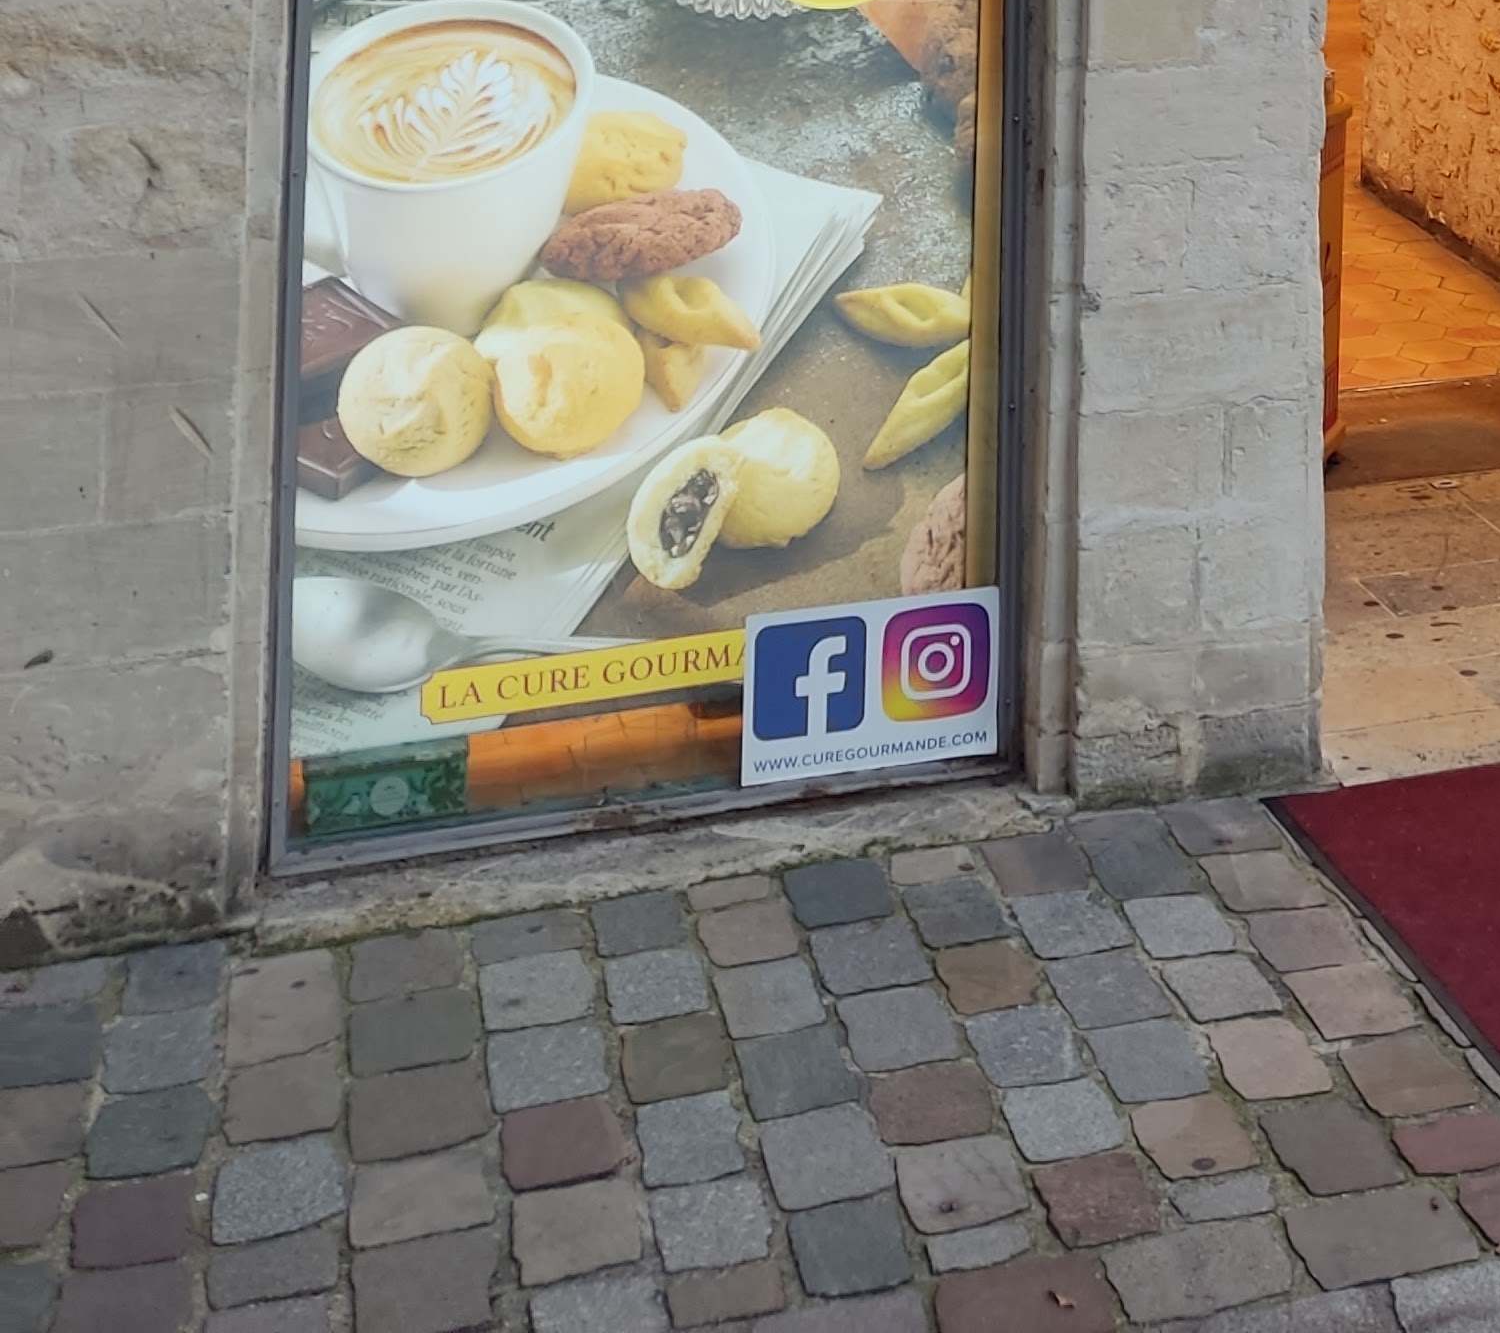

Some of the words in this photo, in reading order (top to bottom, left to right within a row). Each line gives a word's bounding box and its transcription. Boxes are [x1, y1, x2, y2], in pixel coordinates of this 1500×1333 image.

[439, 682, 485, 709] LA
[496, 665, 590, 701] CURE
[753, 730, 988, 773] WWW.CUREGOURMANDE.COM
